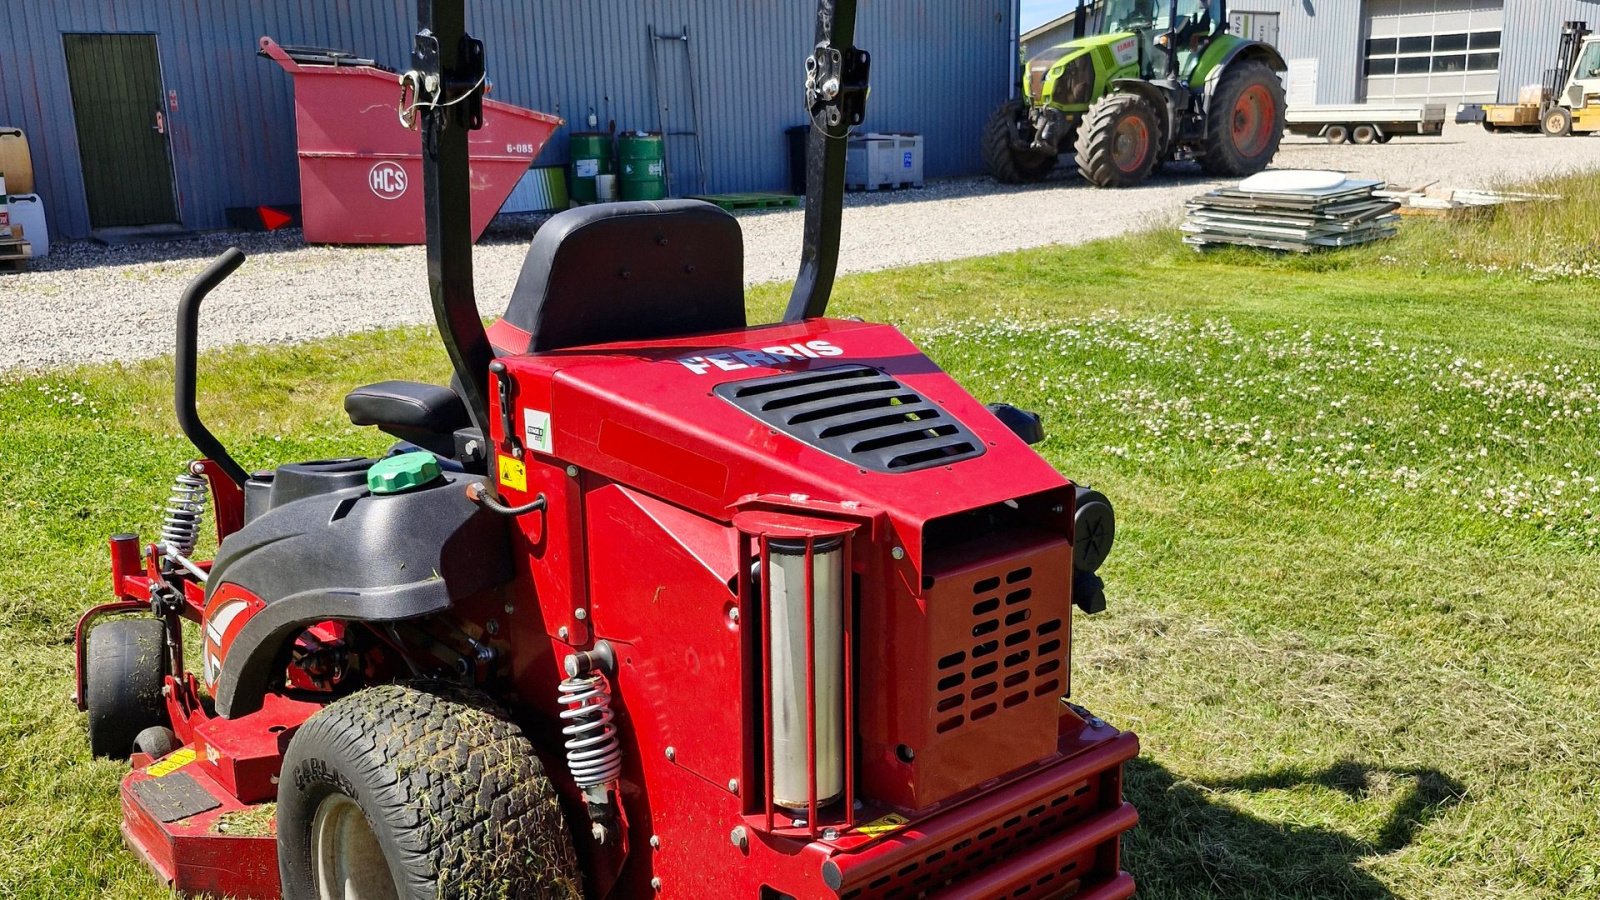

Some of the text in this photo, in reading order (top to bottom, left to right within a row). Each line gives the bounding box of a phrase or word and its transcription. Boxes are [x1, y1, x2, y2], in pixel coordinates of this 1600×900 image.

[506, 143, 533, 153] 6-085
[373, 167, 404, 192] HCS
[678, 340, 844, 375] FERRIS
